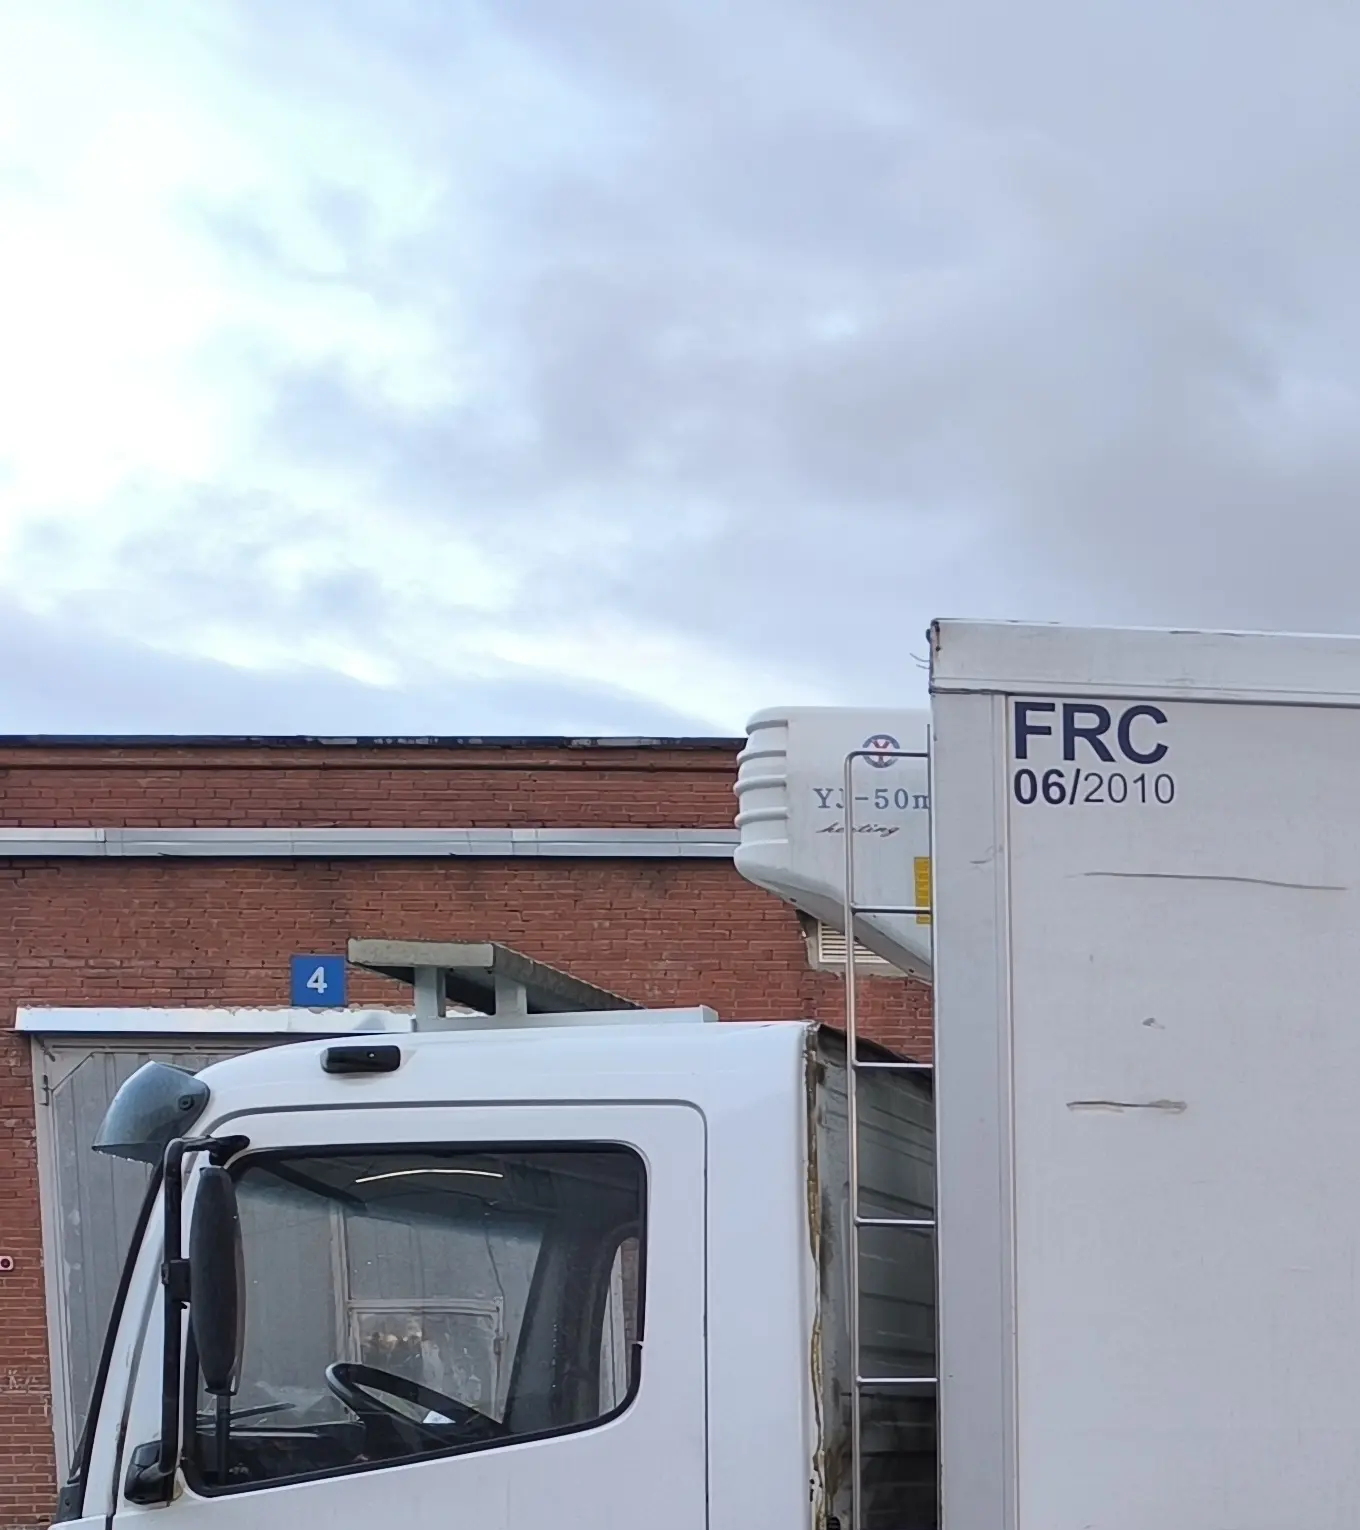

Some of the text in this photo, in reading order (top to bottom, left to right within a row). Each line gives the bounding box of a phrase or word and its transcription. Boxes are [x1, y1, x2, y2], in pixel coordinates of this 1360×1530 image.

[1014, 701, 1169, 764] FRC
[1013, 768, 1175, 805] 06/2010
[306, 966, 328, 994] 4
